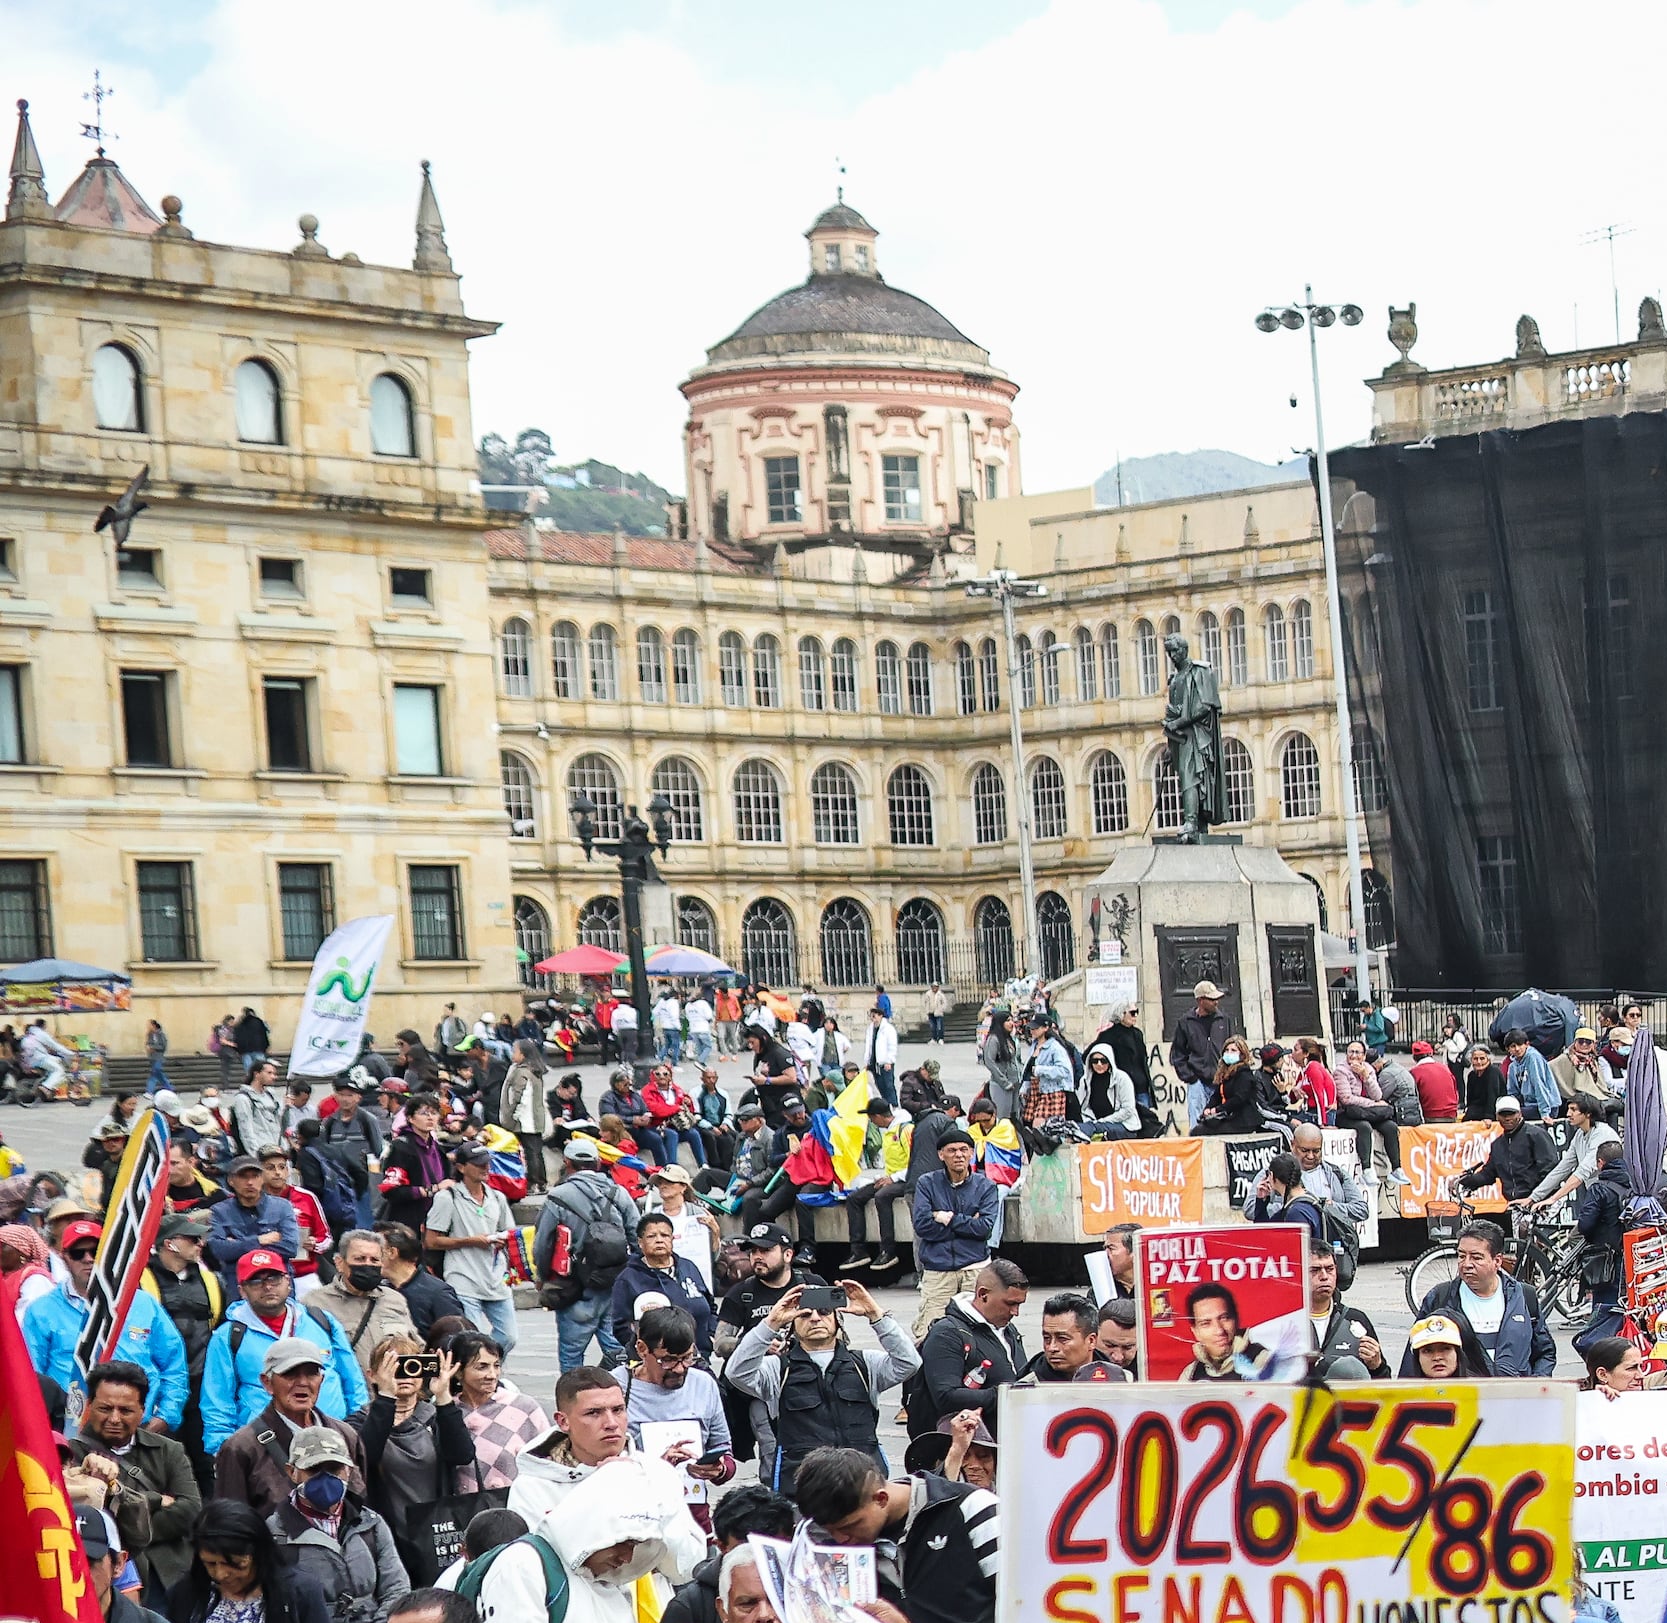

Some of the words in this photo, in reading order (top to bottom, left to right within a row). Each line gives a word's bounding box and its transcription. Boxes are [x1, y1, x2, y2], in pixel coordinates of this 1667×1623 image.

[1088, 1149, 1115, 1213] SÍ
[1116, 1155, 1186, 1188] CONSULTA
[1123, 1189, 1181, 1218] POPULAR
[1148, 1238, 1183, 1261] POR
[1184, 1236, 1207, 1259] LA
[1149, 1259, 1202, 1285] PAZ
[1208, 1254, 1296, 1281] TOTAL
[1045, 1400, 1299, 1566] 2026
[432, 1521, 456, 1533] THE
[1594, 1543, 1632, 1568] AL
